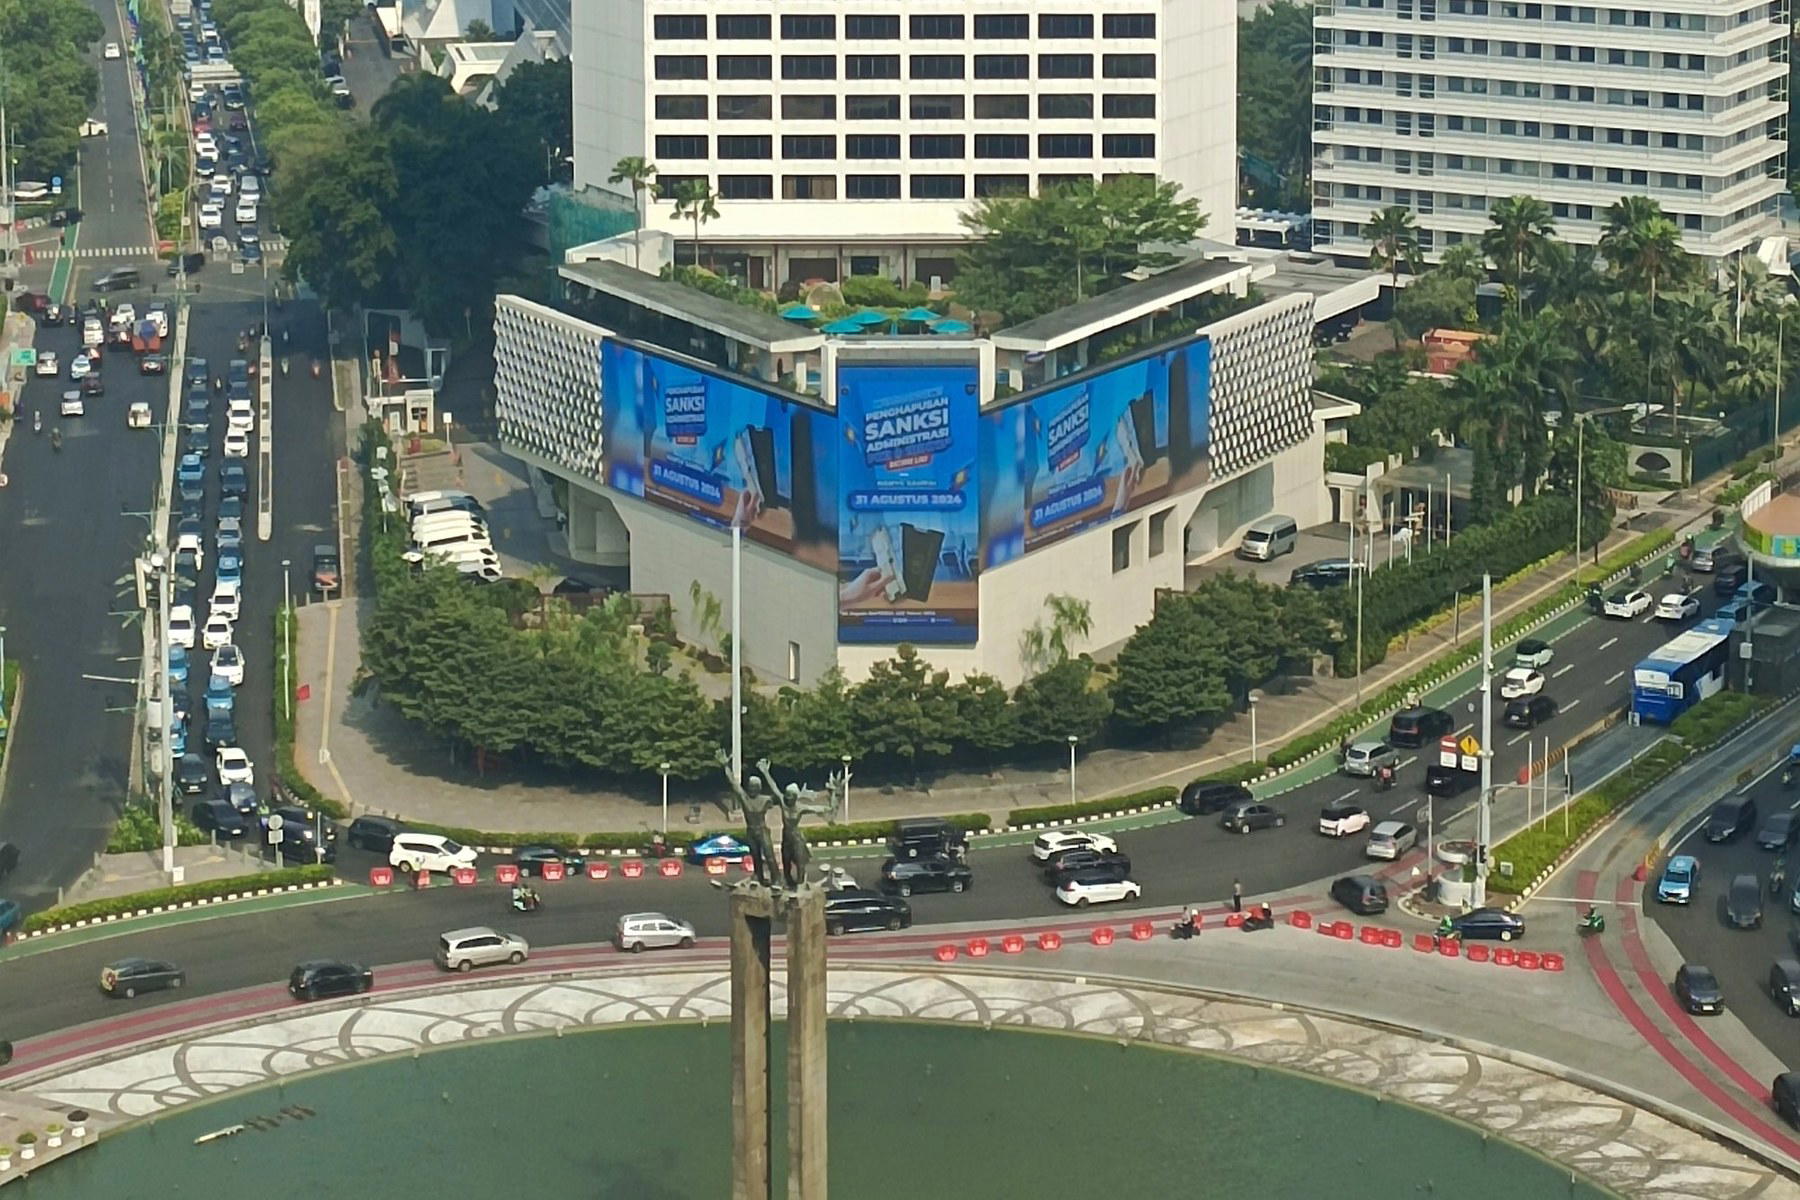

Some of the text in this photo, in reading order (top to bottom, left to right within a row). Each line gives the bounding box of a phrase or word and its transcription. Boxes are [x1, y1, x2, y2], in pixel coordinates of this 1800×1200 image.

[666, 396, 705, 413] SANKSI
[865, 408, 948, 440] SANKSI
[1049, 402, 1088, 446] SANKSI
[870, 495, 928, 505] AGUSTUS
